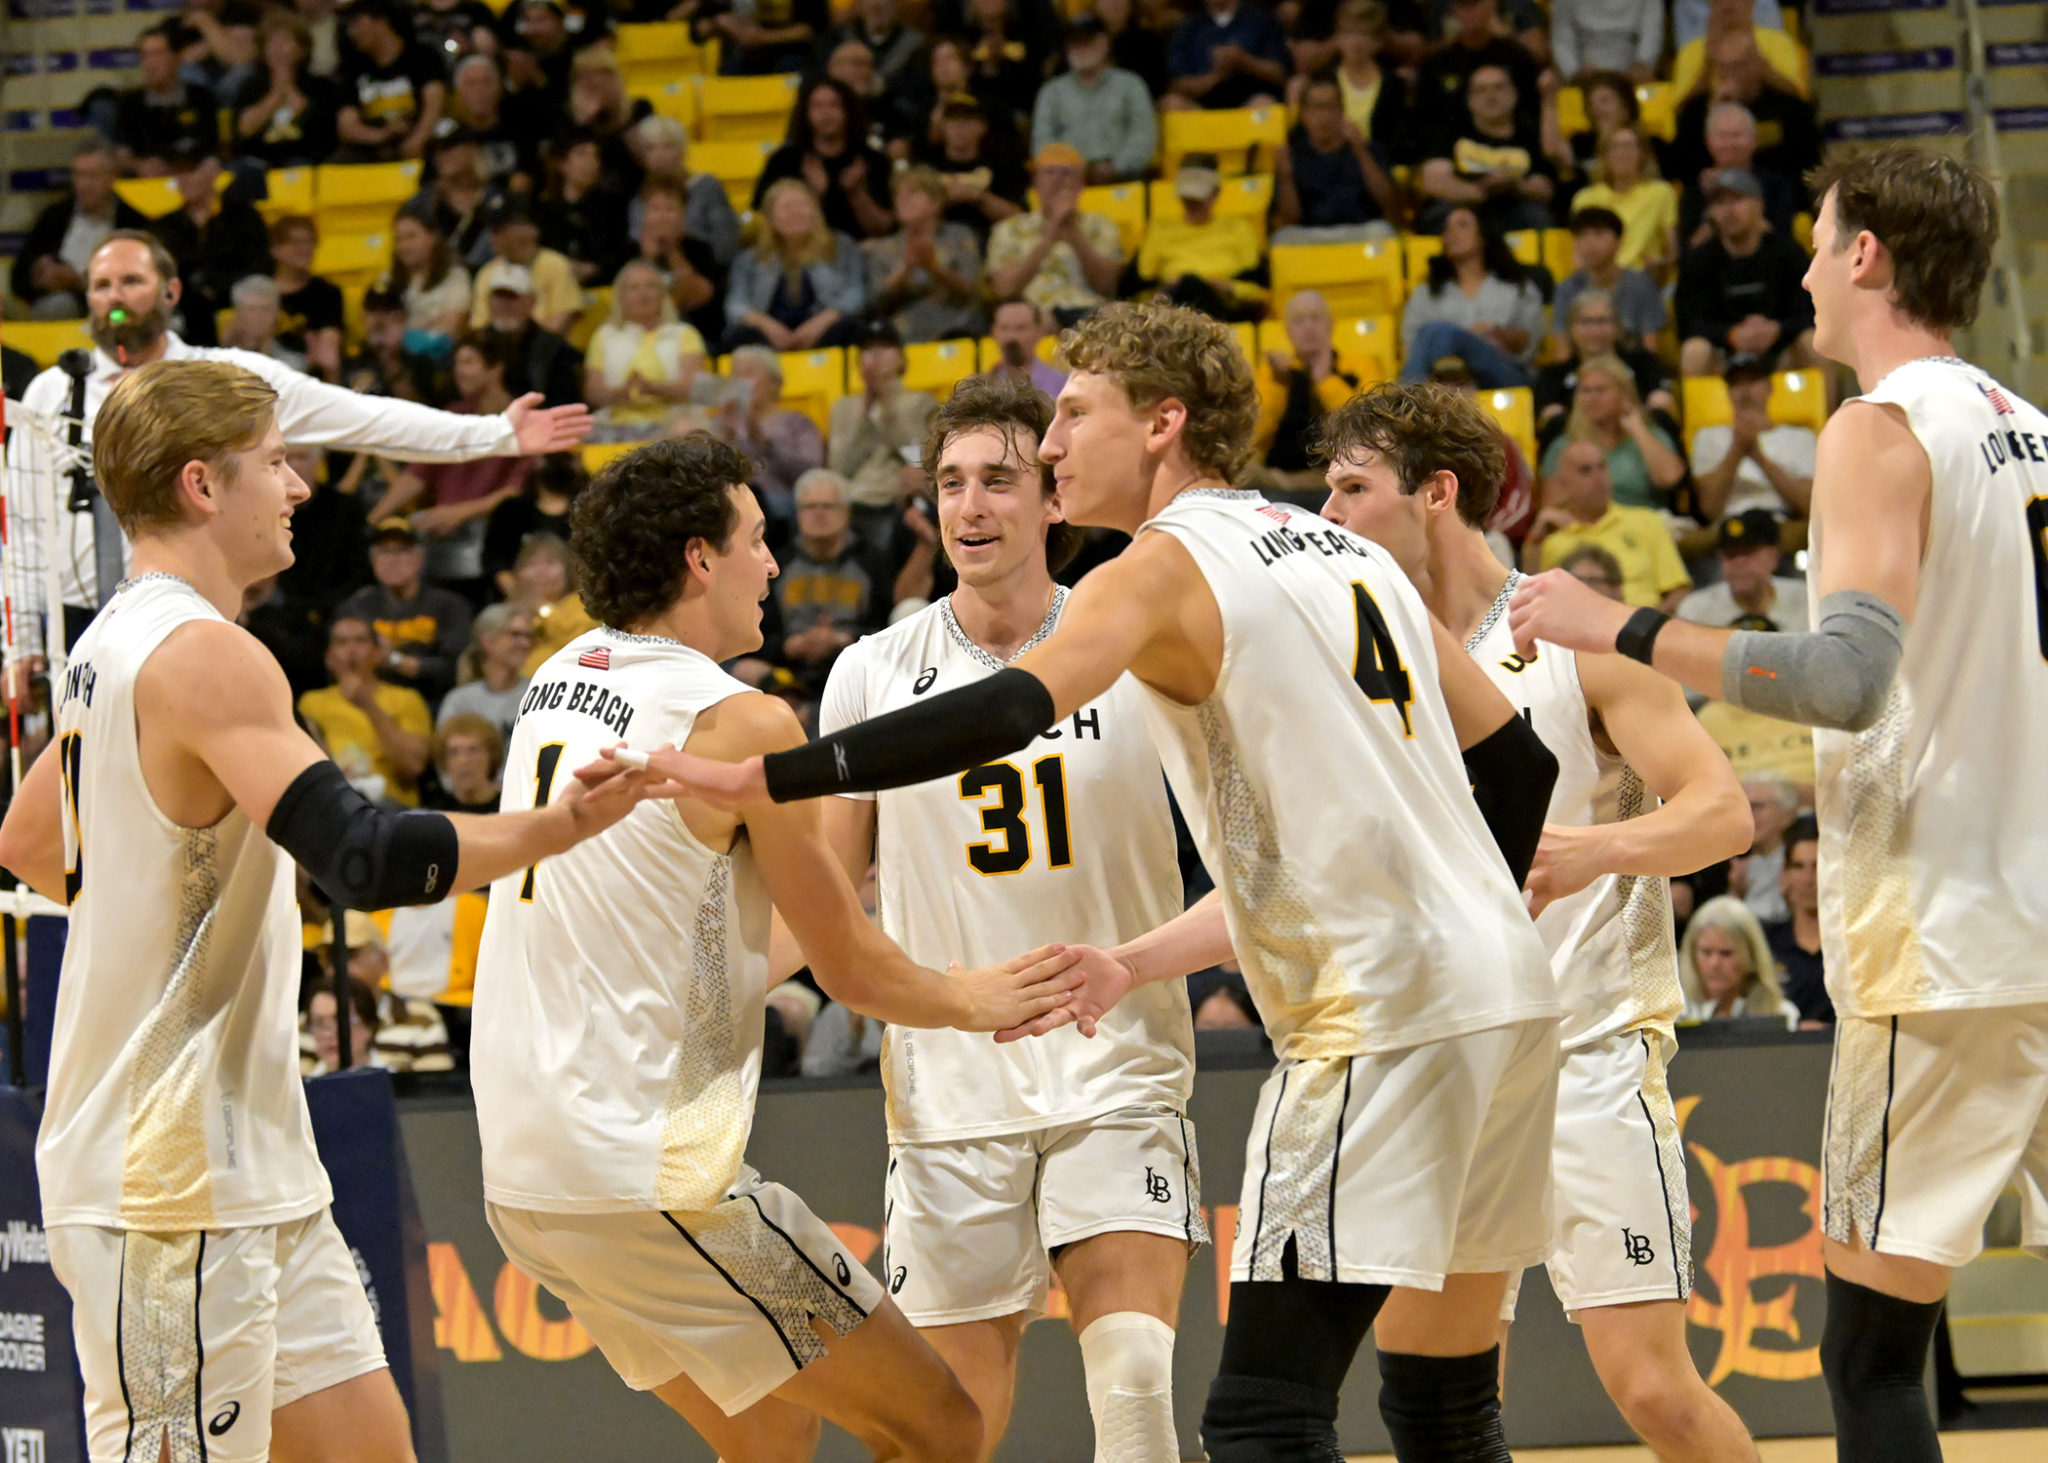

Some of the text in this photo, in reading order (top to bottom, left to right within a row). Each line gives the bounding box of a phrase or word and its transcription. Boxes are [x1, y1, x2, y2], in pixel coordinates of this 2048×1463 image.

[518, 681, 634, 739] ONG BEACH
[1350, 579, 1416, 739] 4
[957, 752, 1074, 877] 31
